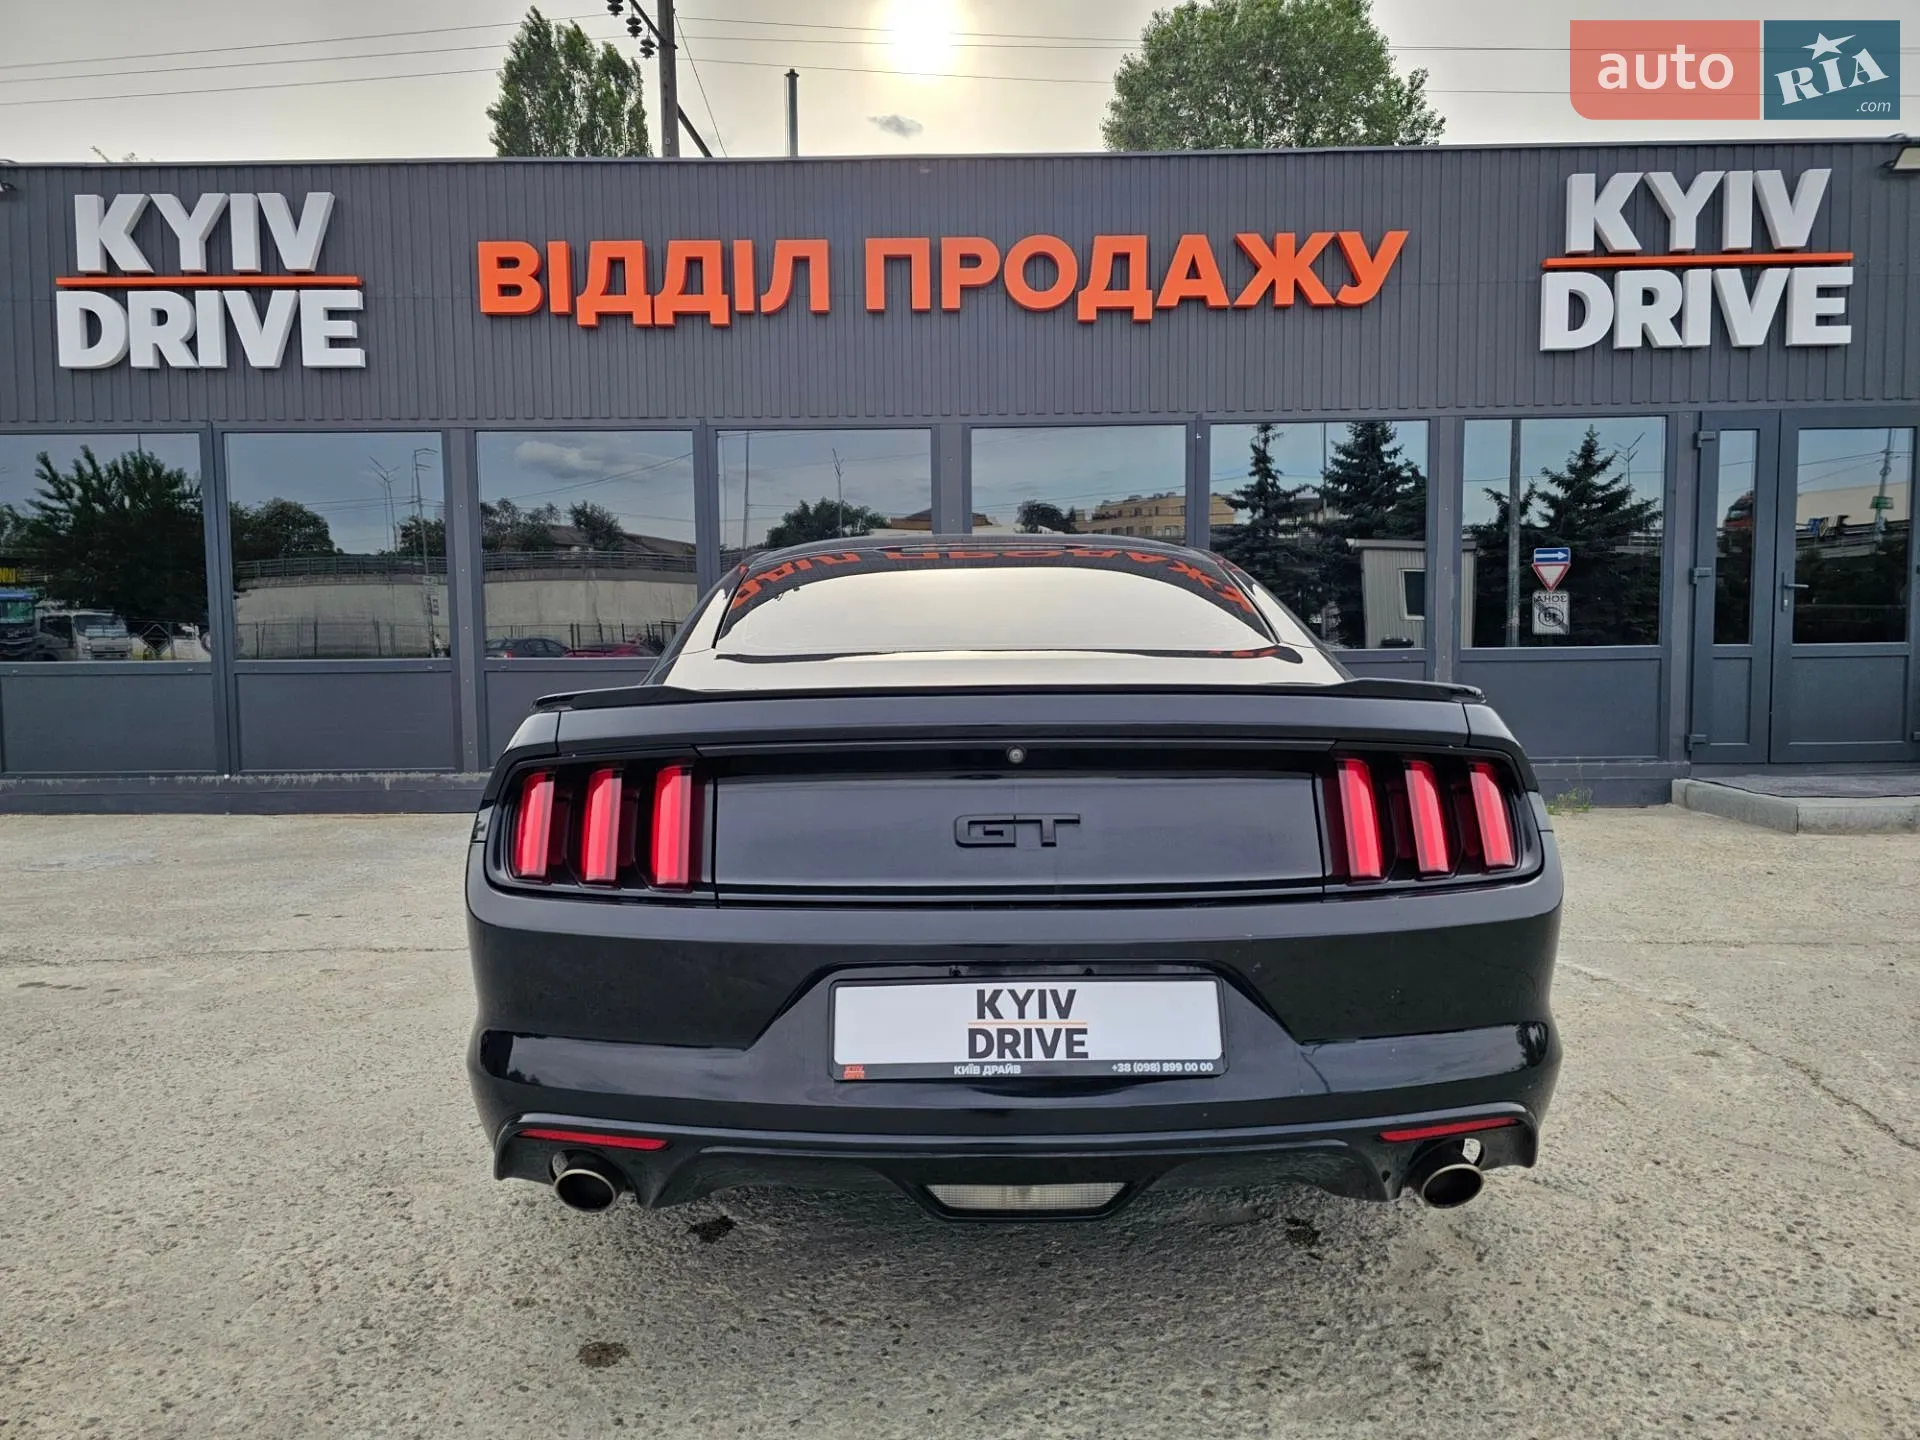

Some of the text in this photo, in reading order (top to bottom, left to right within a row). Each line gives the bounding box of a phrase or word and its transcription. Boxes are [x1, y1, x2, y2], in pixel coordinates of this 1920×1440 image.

[74, 191, 335, 273] KYIV
[1565, 168, 1832, 254] KYIV
[477, 230, 1410, 328] ВІДДІЛ ПРОДАЖУ
[56, 289, 366, 369] DRIVE
[1540, 266, 1854, 351] DRIVE
[955, 813, 1080, 848] GT
[976, 989, 1077, 1019] KYIV
[953, 1063, 1022, 1076] КИЇВ ДРАЙВ
[967, 1028, 1089, 1059] DRIVE
[1111, 1062, 1214, 1073] +38 (098) 899 00 00
